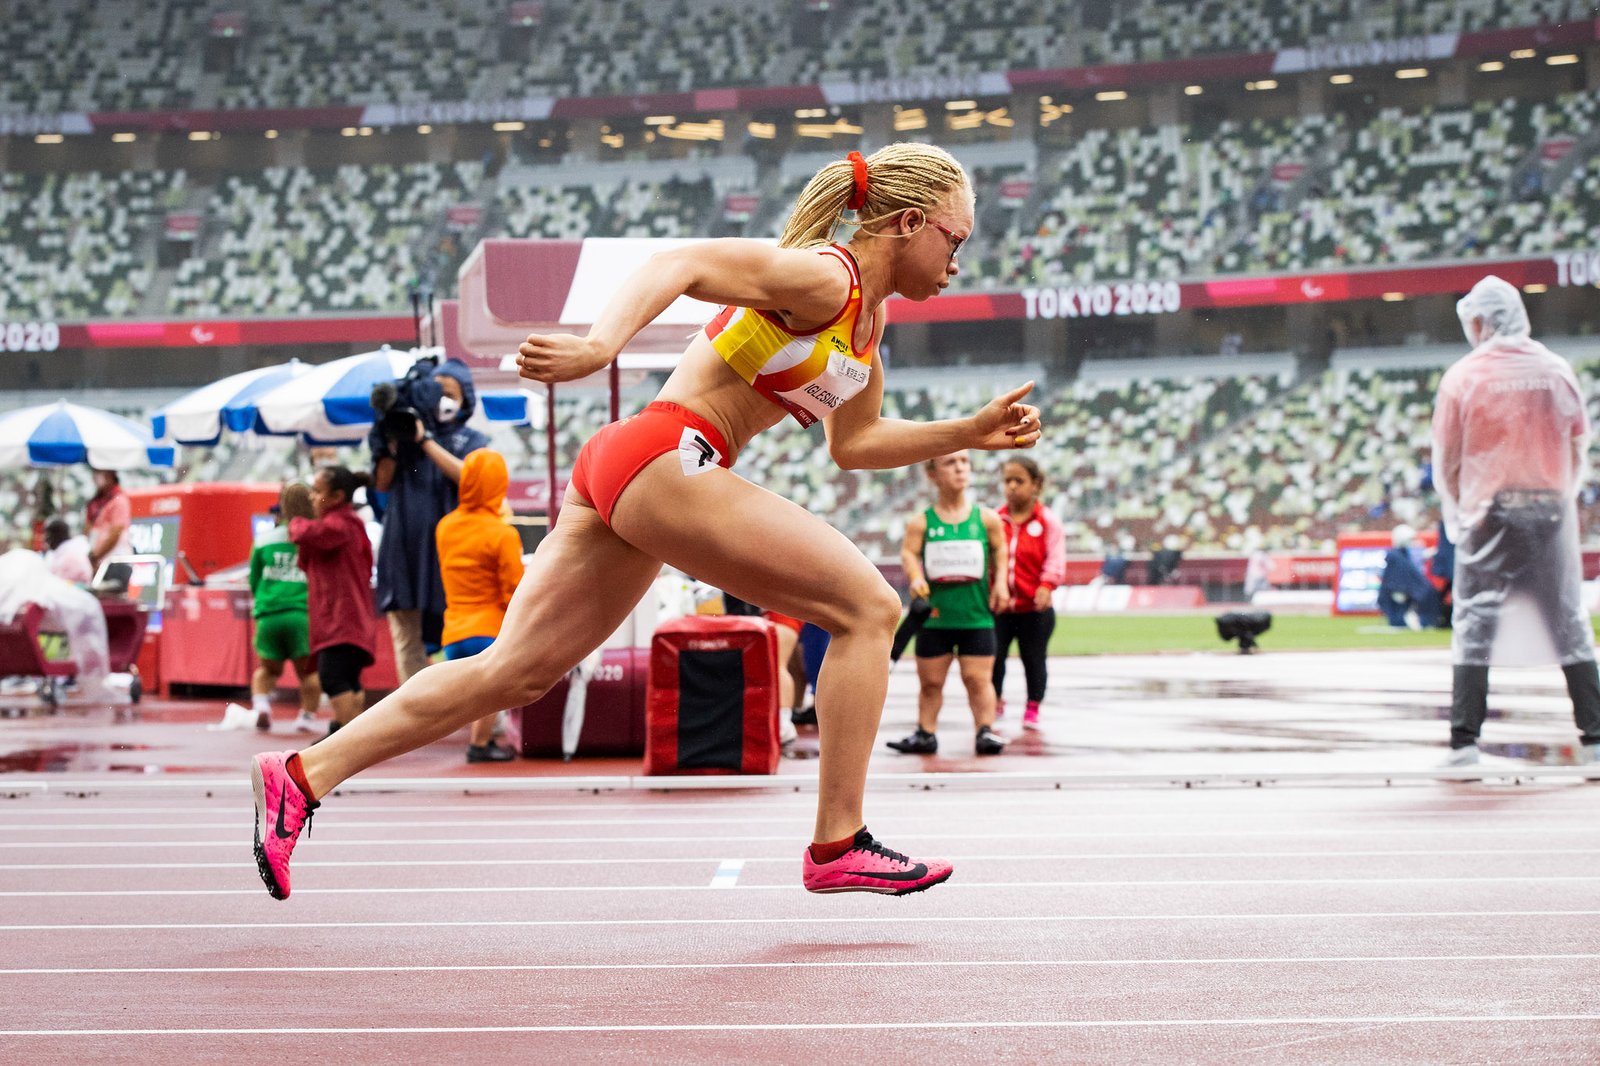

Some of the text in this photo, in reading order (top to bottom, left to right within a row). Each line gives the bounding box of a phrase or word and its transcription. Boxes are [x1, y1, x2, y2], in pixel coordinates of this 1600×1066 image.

[1021, 281, 1181, 320] TOKYO 2020
[804, 383, 840, 408] IGLESIAS
[797, 409, 812, 424] TOKYO
[694, 434, 715, 468] 7
[593, 664, 624, 681] 020
